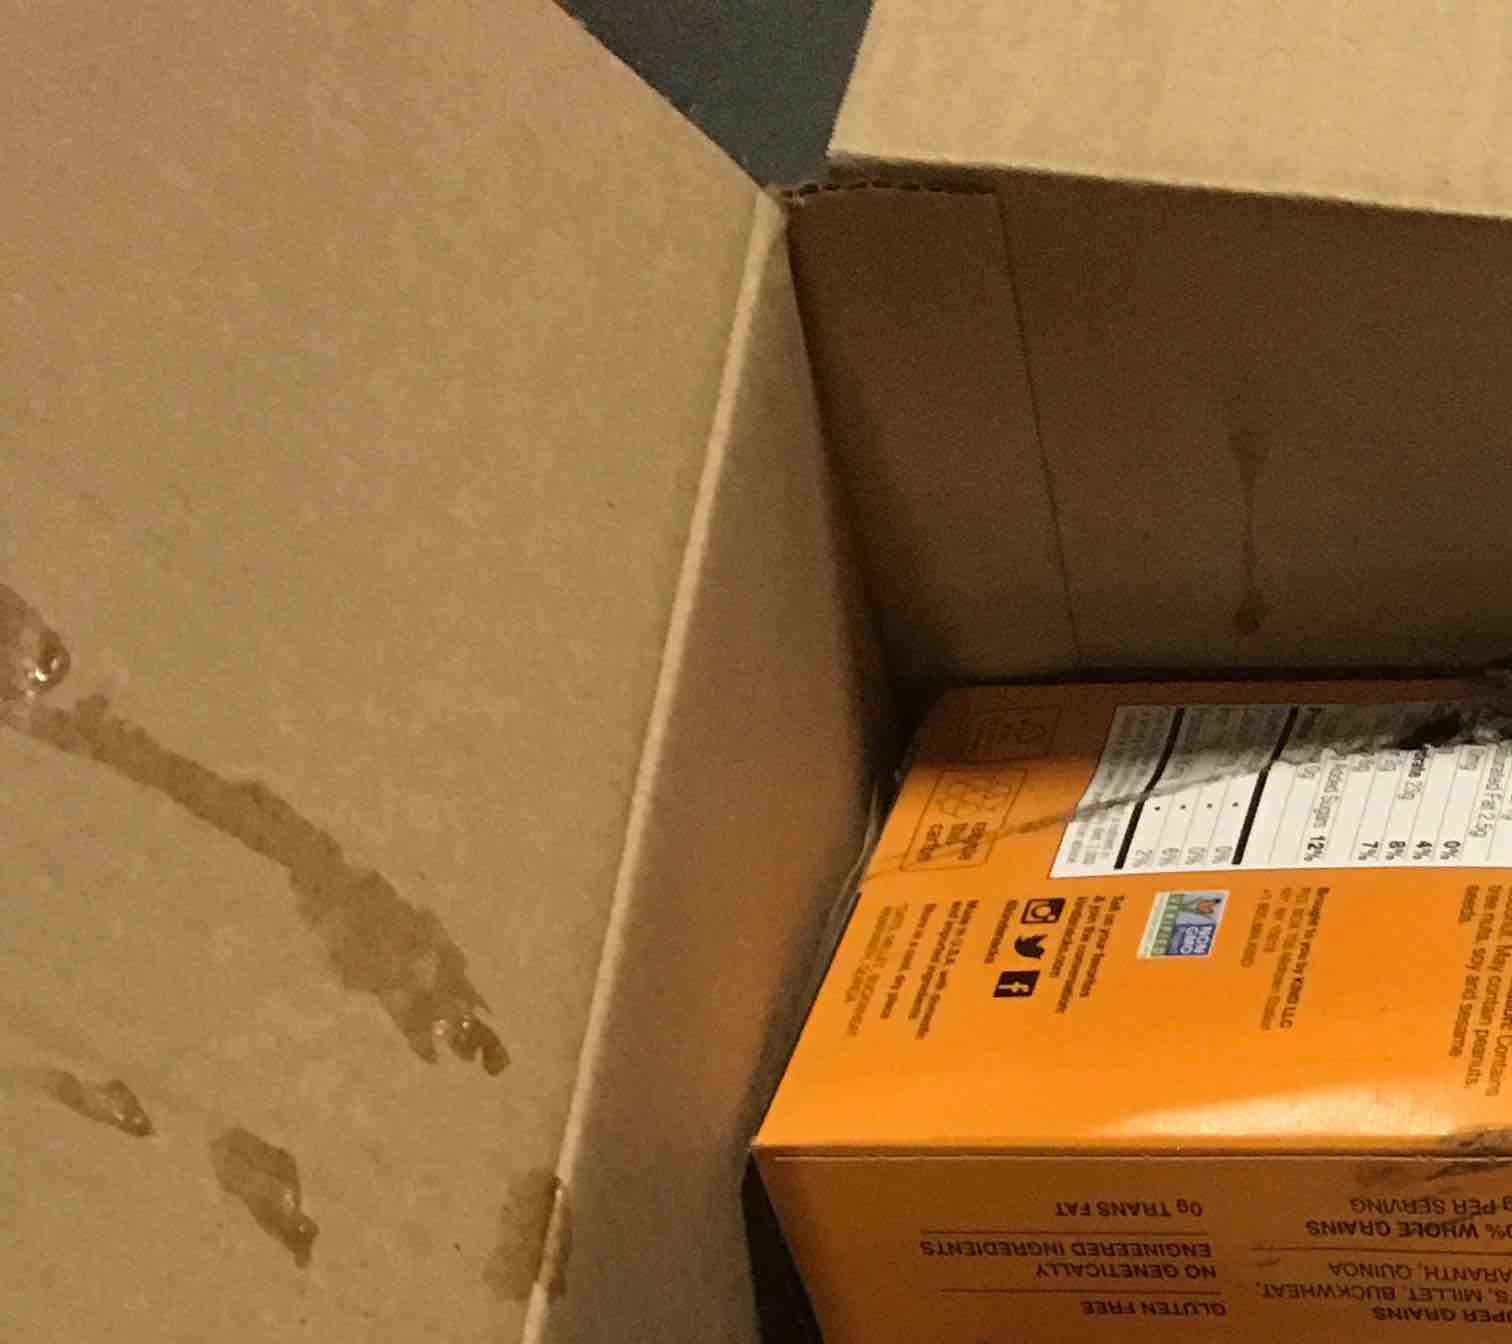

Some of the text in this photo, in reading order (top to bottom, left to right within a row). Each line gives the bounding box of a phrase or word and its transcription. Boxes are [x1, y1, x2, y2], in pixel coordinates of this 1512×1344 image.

[1053, 1199, 1170, 1217] TRANS FAT
[1348, 1196, 1445, 1215] SERVING
[1304, 1218, 1391, 1237] GRAINS
[1396, 1219, 1478, 1238] WHOLE
[919, 1238, 1211, 1258] ENGINEERED INGREDIENTS
[1035, 1261, 1215, 1279] NO GENETICALLY
[1327, 1261, 1410, 1280] QUINOA
[1253, 1280, 1395, 1300] BUCKWHEAT,
[1081, 1299, 1225, 1317] GLUTEN FREE
[1371, 1305, 1454, 1323] GRAINS
